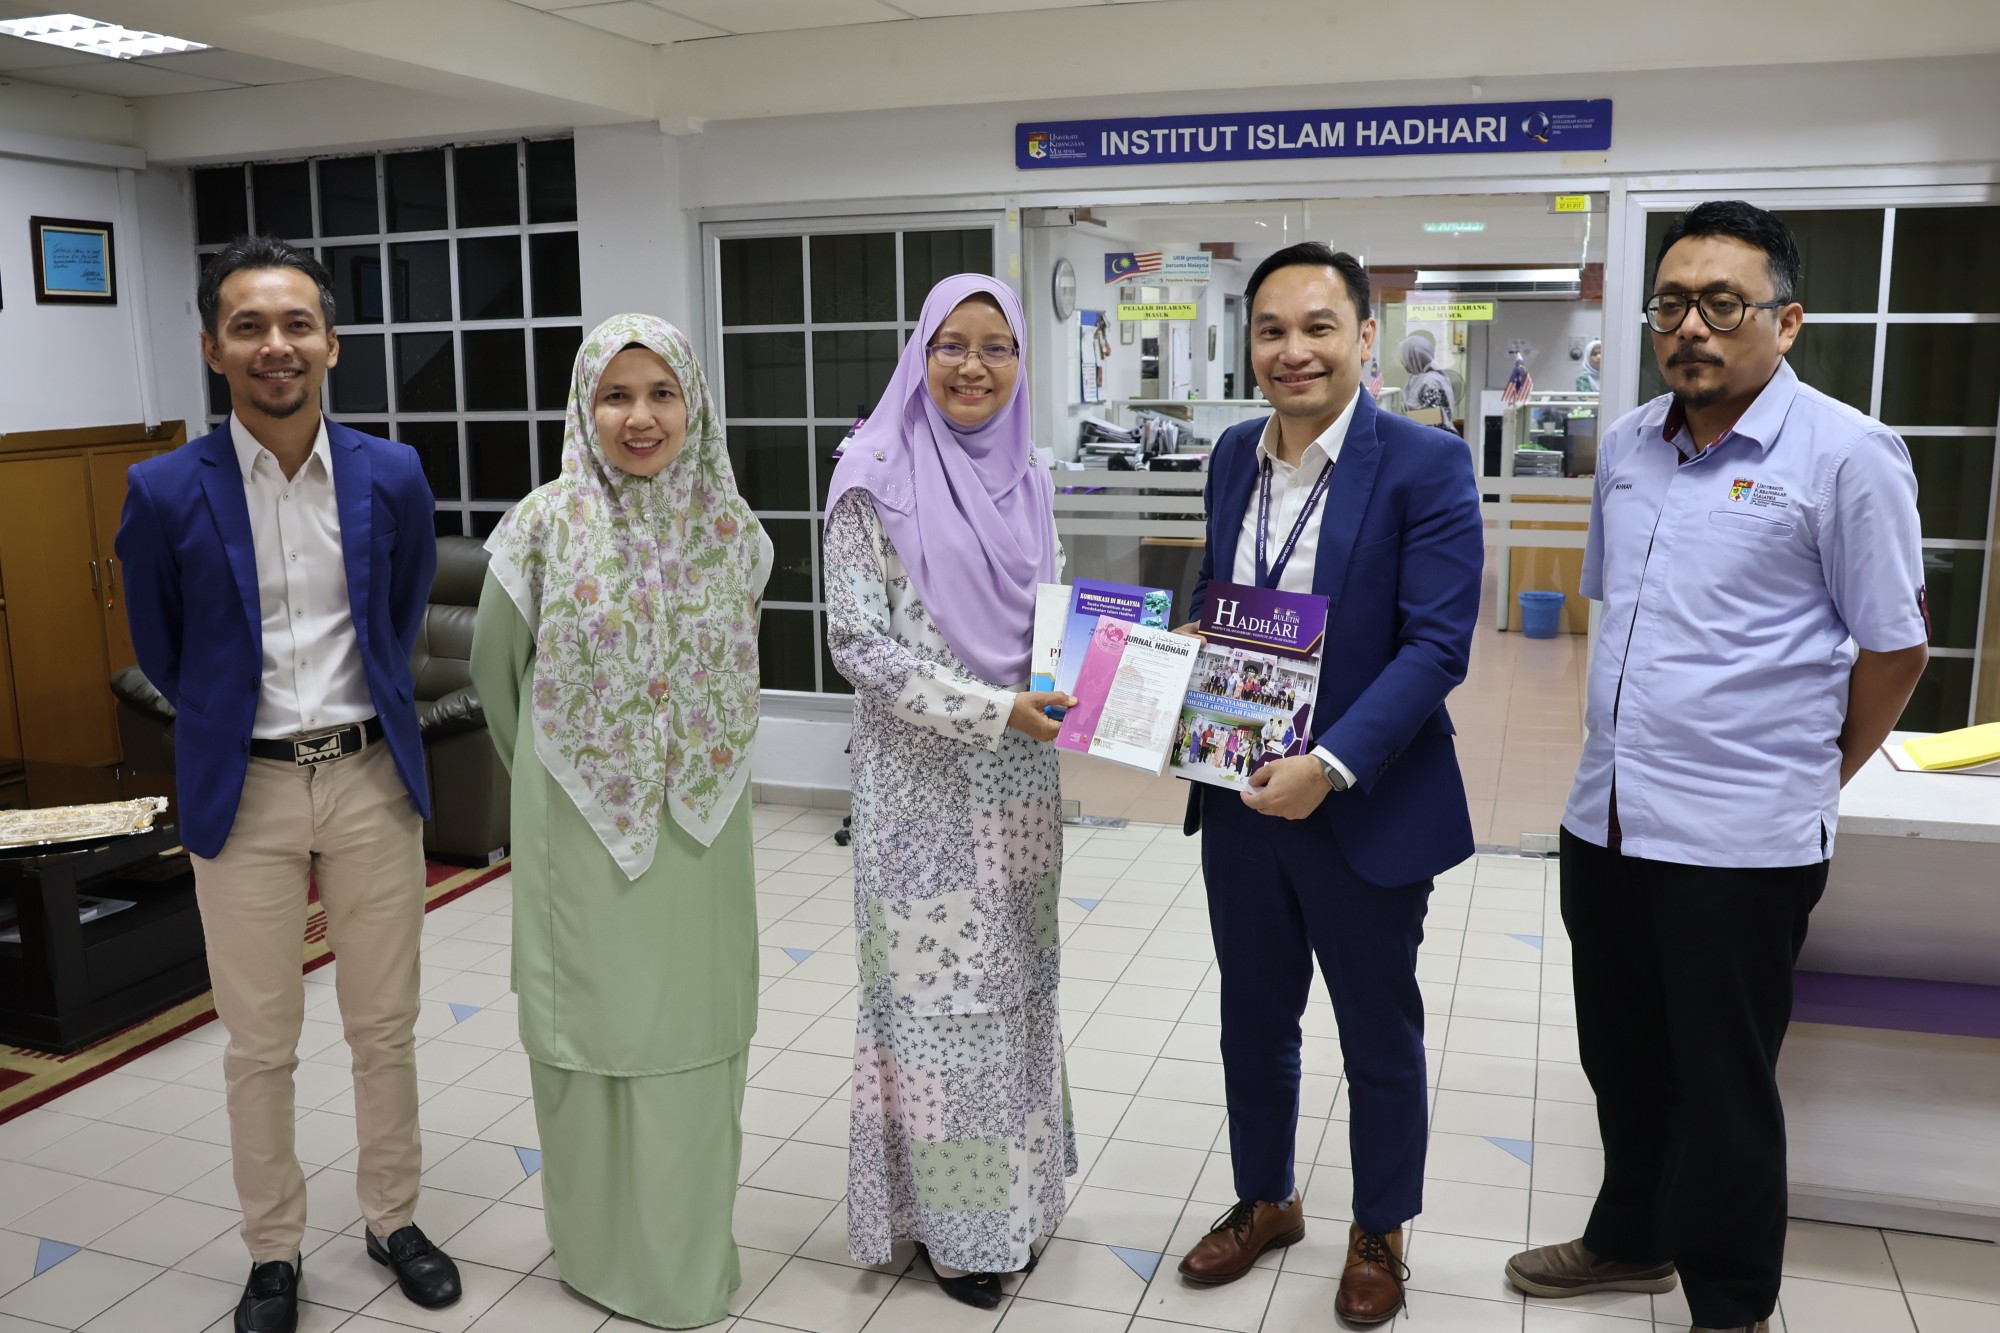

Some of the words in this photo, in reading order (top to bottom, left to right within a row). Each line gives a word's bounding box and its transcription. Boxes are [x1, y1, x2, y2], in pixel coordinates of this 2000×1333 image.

[1101, 126, 1238, 156] INSTITUT
[1248, 121, 1345, 151] ISLAM
[1356, 116, 1507, 146] HADHARI
[1300, 502, 1313, 523] NATIONAL
[1289, 523, 1302, 545] SECURITY
[1278, 545, 1291, 565] COUNCIL
[1080, 592, 1110, 603] KOMUNIKASI
[1117, 598, 1140, 608] MALAYSIA
[1213, 598, 1299, 639] HADHARI
[1273, 613, 1300, 624] BULETIN
[1123, 634, 1153, 648] JURNAL
[1155, 642, 1189, 657] HADHARI
[1186, 699, 1209, 708] SHEIKH
[1209, 703, 1243, 716] ABDULLAH
[1188, 691, 1216, 702] HADHARI
[1216, 697, 1259, 711] PENYAMBUNG
[1259, 706, 1281, 716] LEGASI
